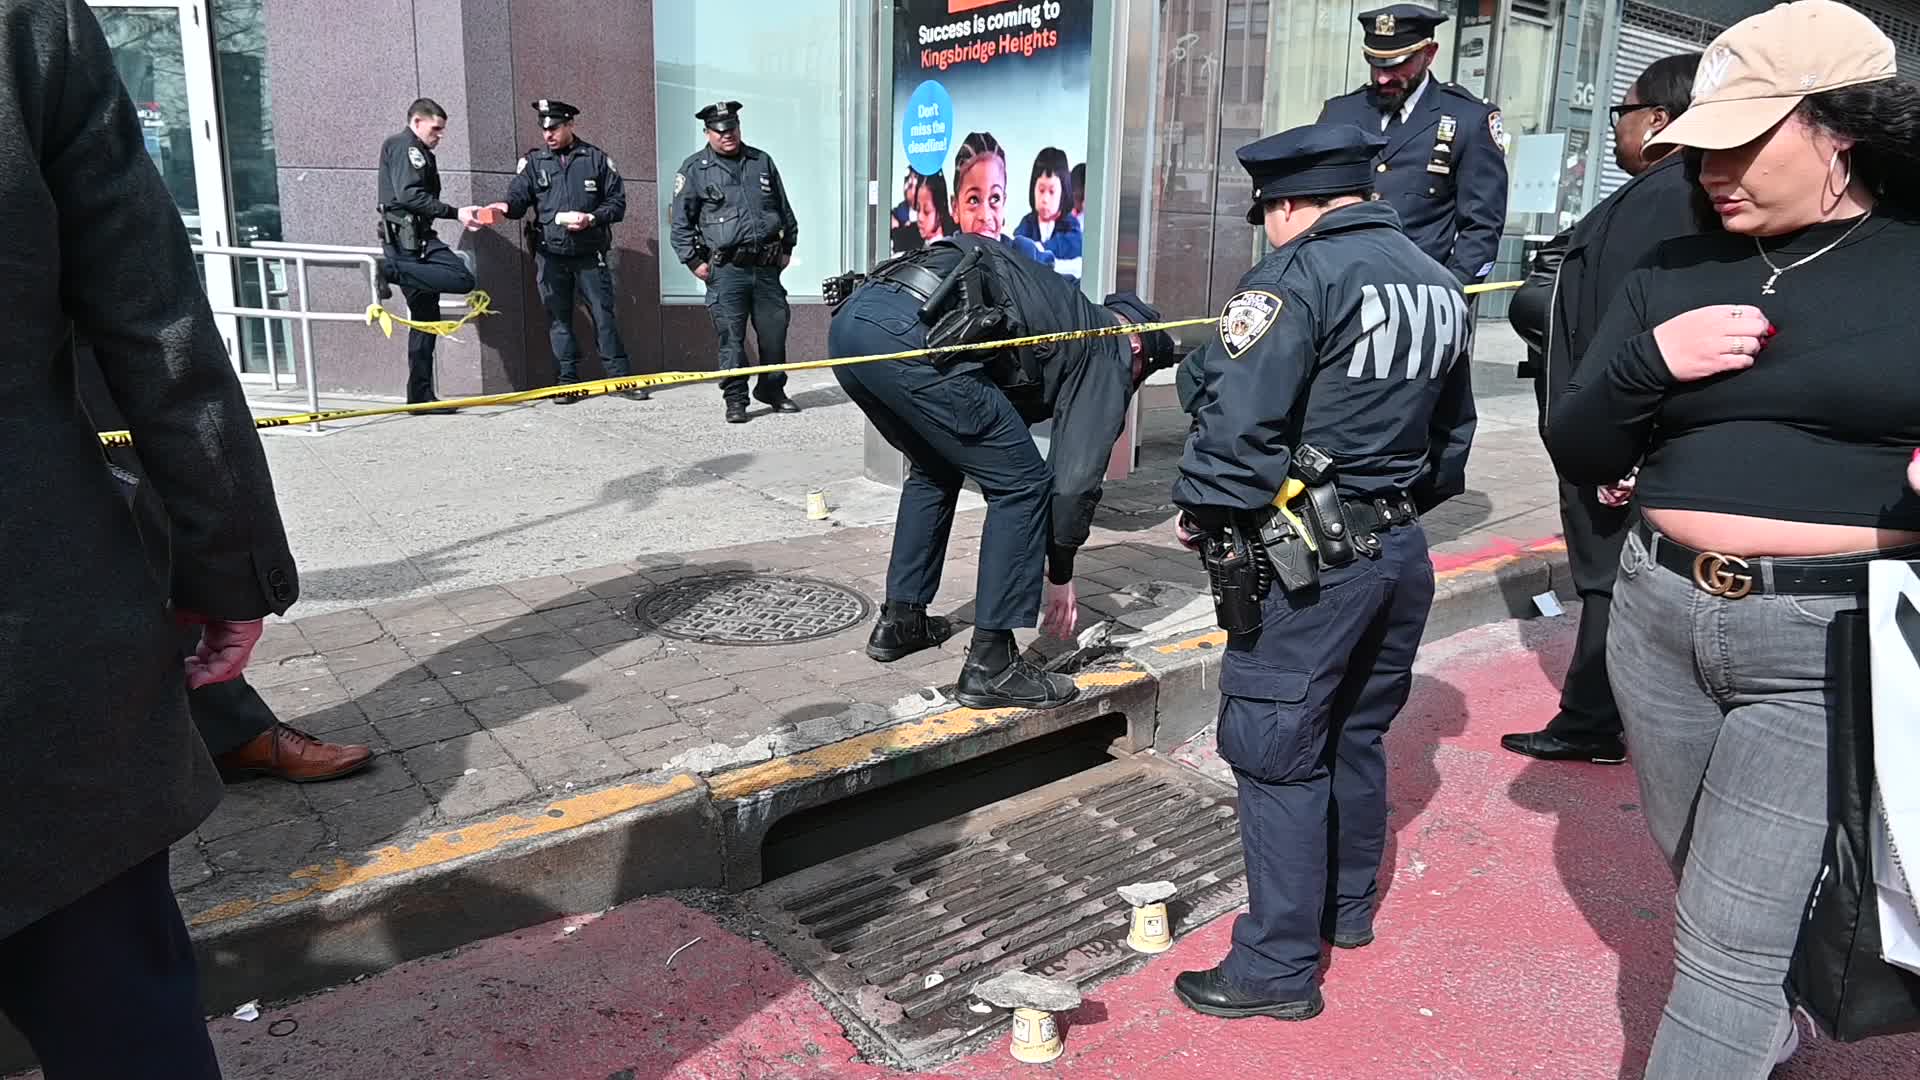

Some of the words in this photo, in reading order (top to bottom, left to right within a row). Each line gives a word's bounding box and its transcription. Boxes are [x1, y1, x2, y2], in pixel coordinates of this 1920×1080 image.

[918, 19, 971, 45] Success
[973, 14, 986, 34] is
[987, 4, 1041, 29] coming
[1042, 0, 1061, 20] to
[920, 39, 996, 70] Kingsbridge
[998, 29, 1057, 57] Heights
[1574, 82, 1596, 105] 5G
[917, 103, 939, 119] Don't
[910, 122, 932, 137] miss
[932, 120, 946, 134] the
[908, 137, 947, 154] deadline!
